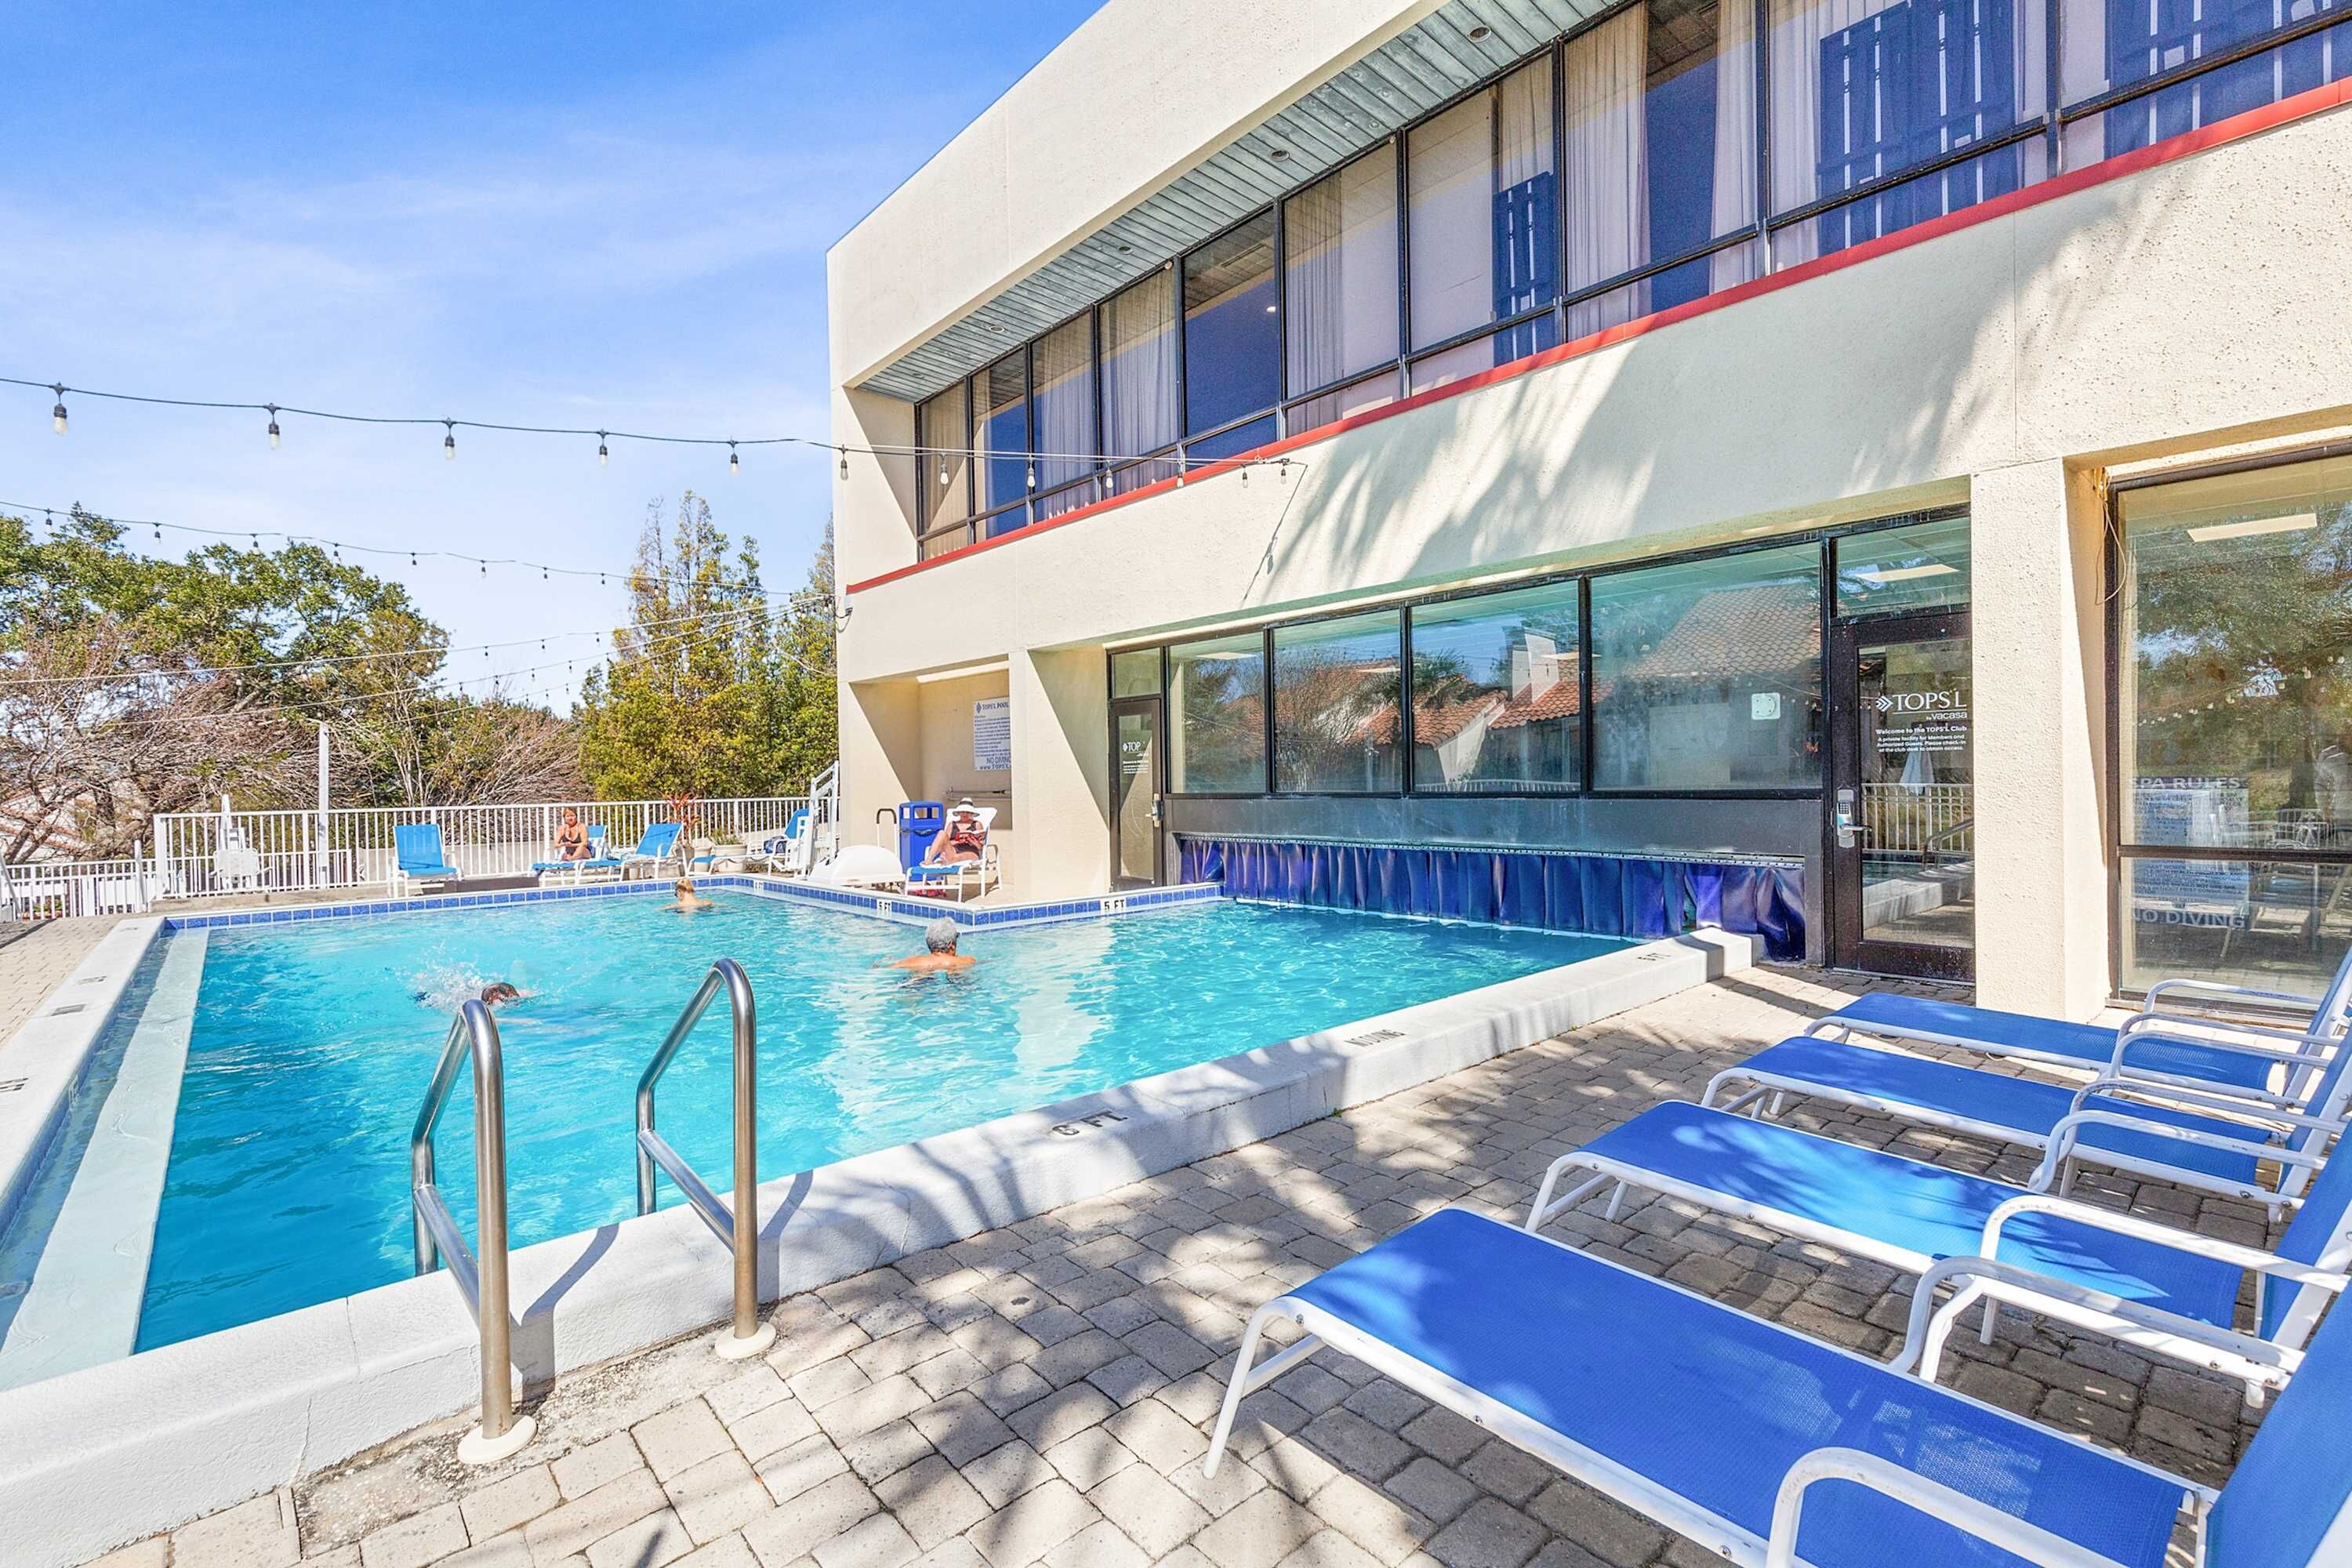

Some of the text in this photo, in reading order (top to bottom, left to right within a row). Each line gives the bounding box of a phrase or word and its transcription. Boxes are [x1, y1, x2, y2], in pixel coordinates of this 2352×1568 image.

[2173, 777, 2241, 789] RULES
[1105, 899, 1124, 909] 5 FT
[2166, 911, 2245, 928] DIVING
